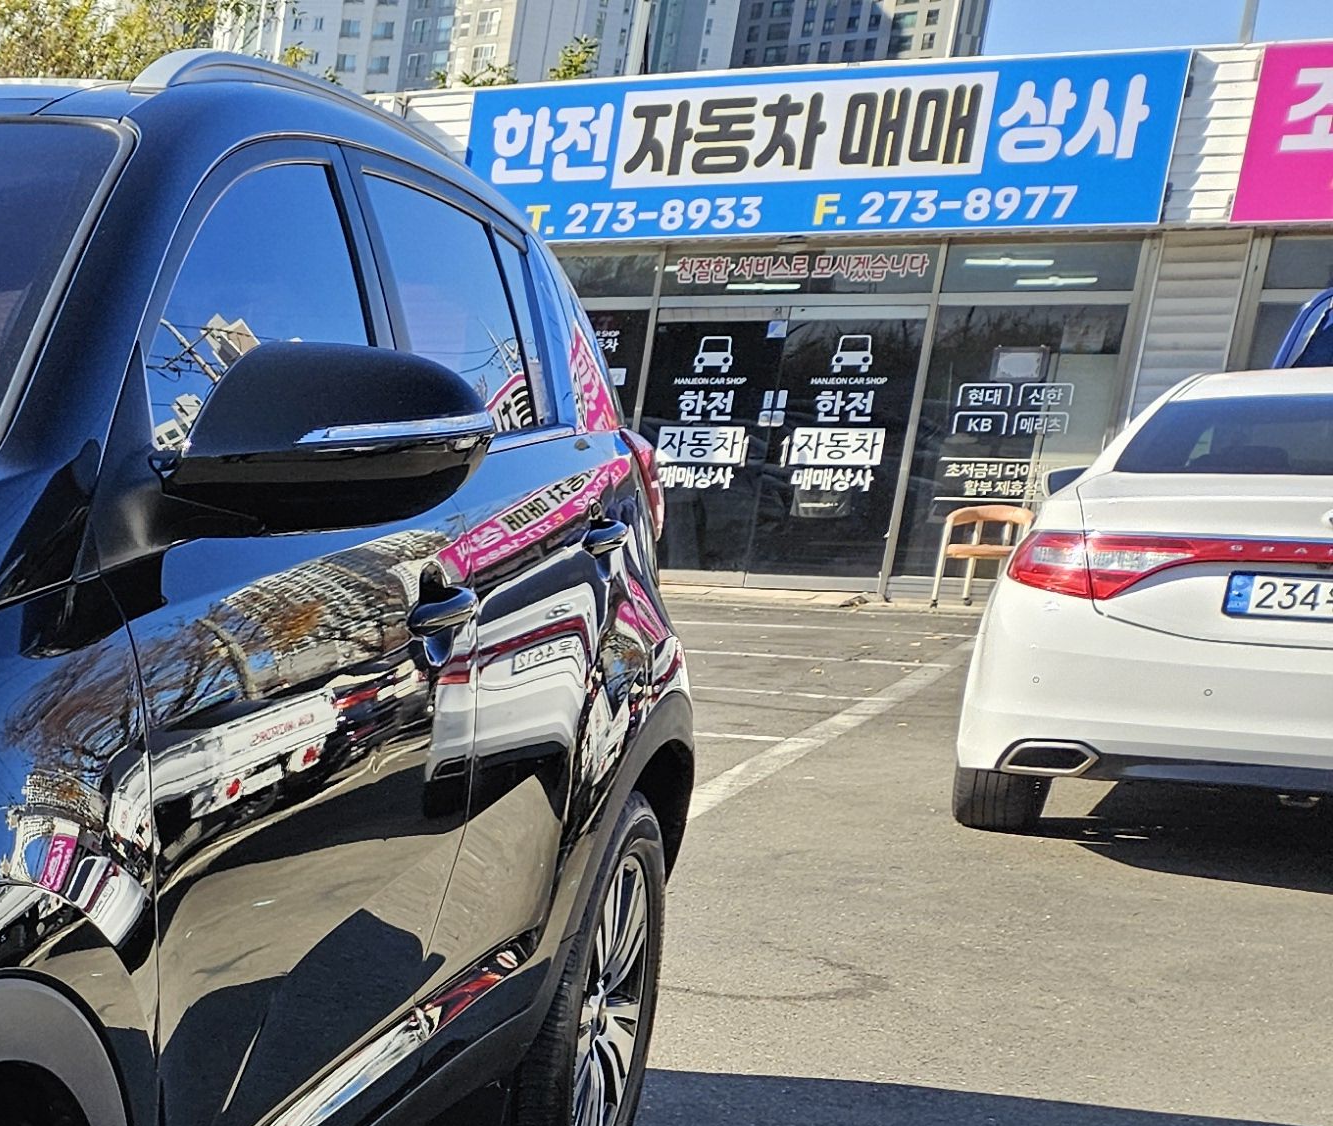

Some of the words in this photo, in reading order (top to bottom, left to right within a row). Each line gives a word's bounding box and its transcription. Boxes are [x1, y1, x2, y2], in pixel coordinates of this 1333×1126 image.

[491, 102, 612, 185] 한전
[623, 87, 827, 176] 자동차
[839, 82, 984, 169] 매매
[996, 73, 1150, 164] 상사
[564, 196, 763, 234] 273-8933
[813, 191, 846, 227] F.
[857, 184, 1079, 226] 273-8977
[677, 257, 731, 283] 친절한
[735, 255, 809, 280] 서비스로
[812, 253, 930, 282] 모시겠습니다
[673, 377, 709, 385] HANJEON
[709, 377, 725, 385] CAR
[726, 377, 747, 385] SHOP
[810, 377, 848, 385] HANJEON
[848, 377, 865, 385] CAR
[866, 377, 888, 385] SHOP
[678, 390, 735, 422] 한전
[815, 390, 875, 422] 한전
[968, 388, 1002, 406] 현대
[1029, 388, 1064, 406] 신한
[967, 418, 992, 432] KB
[1019, 417, 1062, 434] 메리츠
[661, 431, 739, 458] 자동차
[797, 432, 880, 460] 자동차
[659, 465, 734, 490] 매매상사
[791, 466, 874, 492] 매매상사
[944, 463, 1002, 479] 초저금리
[964, 480, 992, 496] 할부
